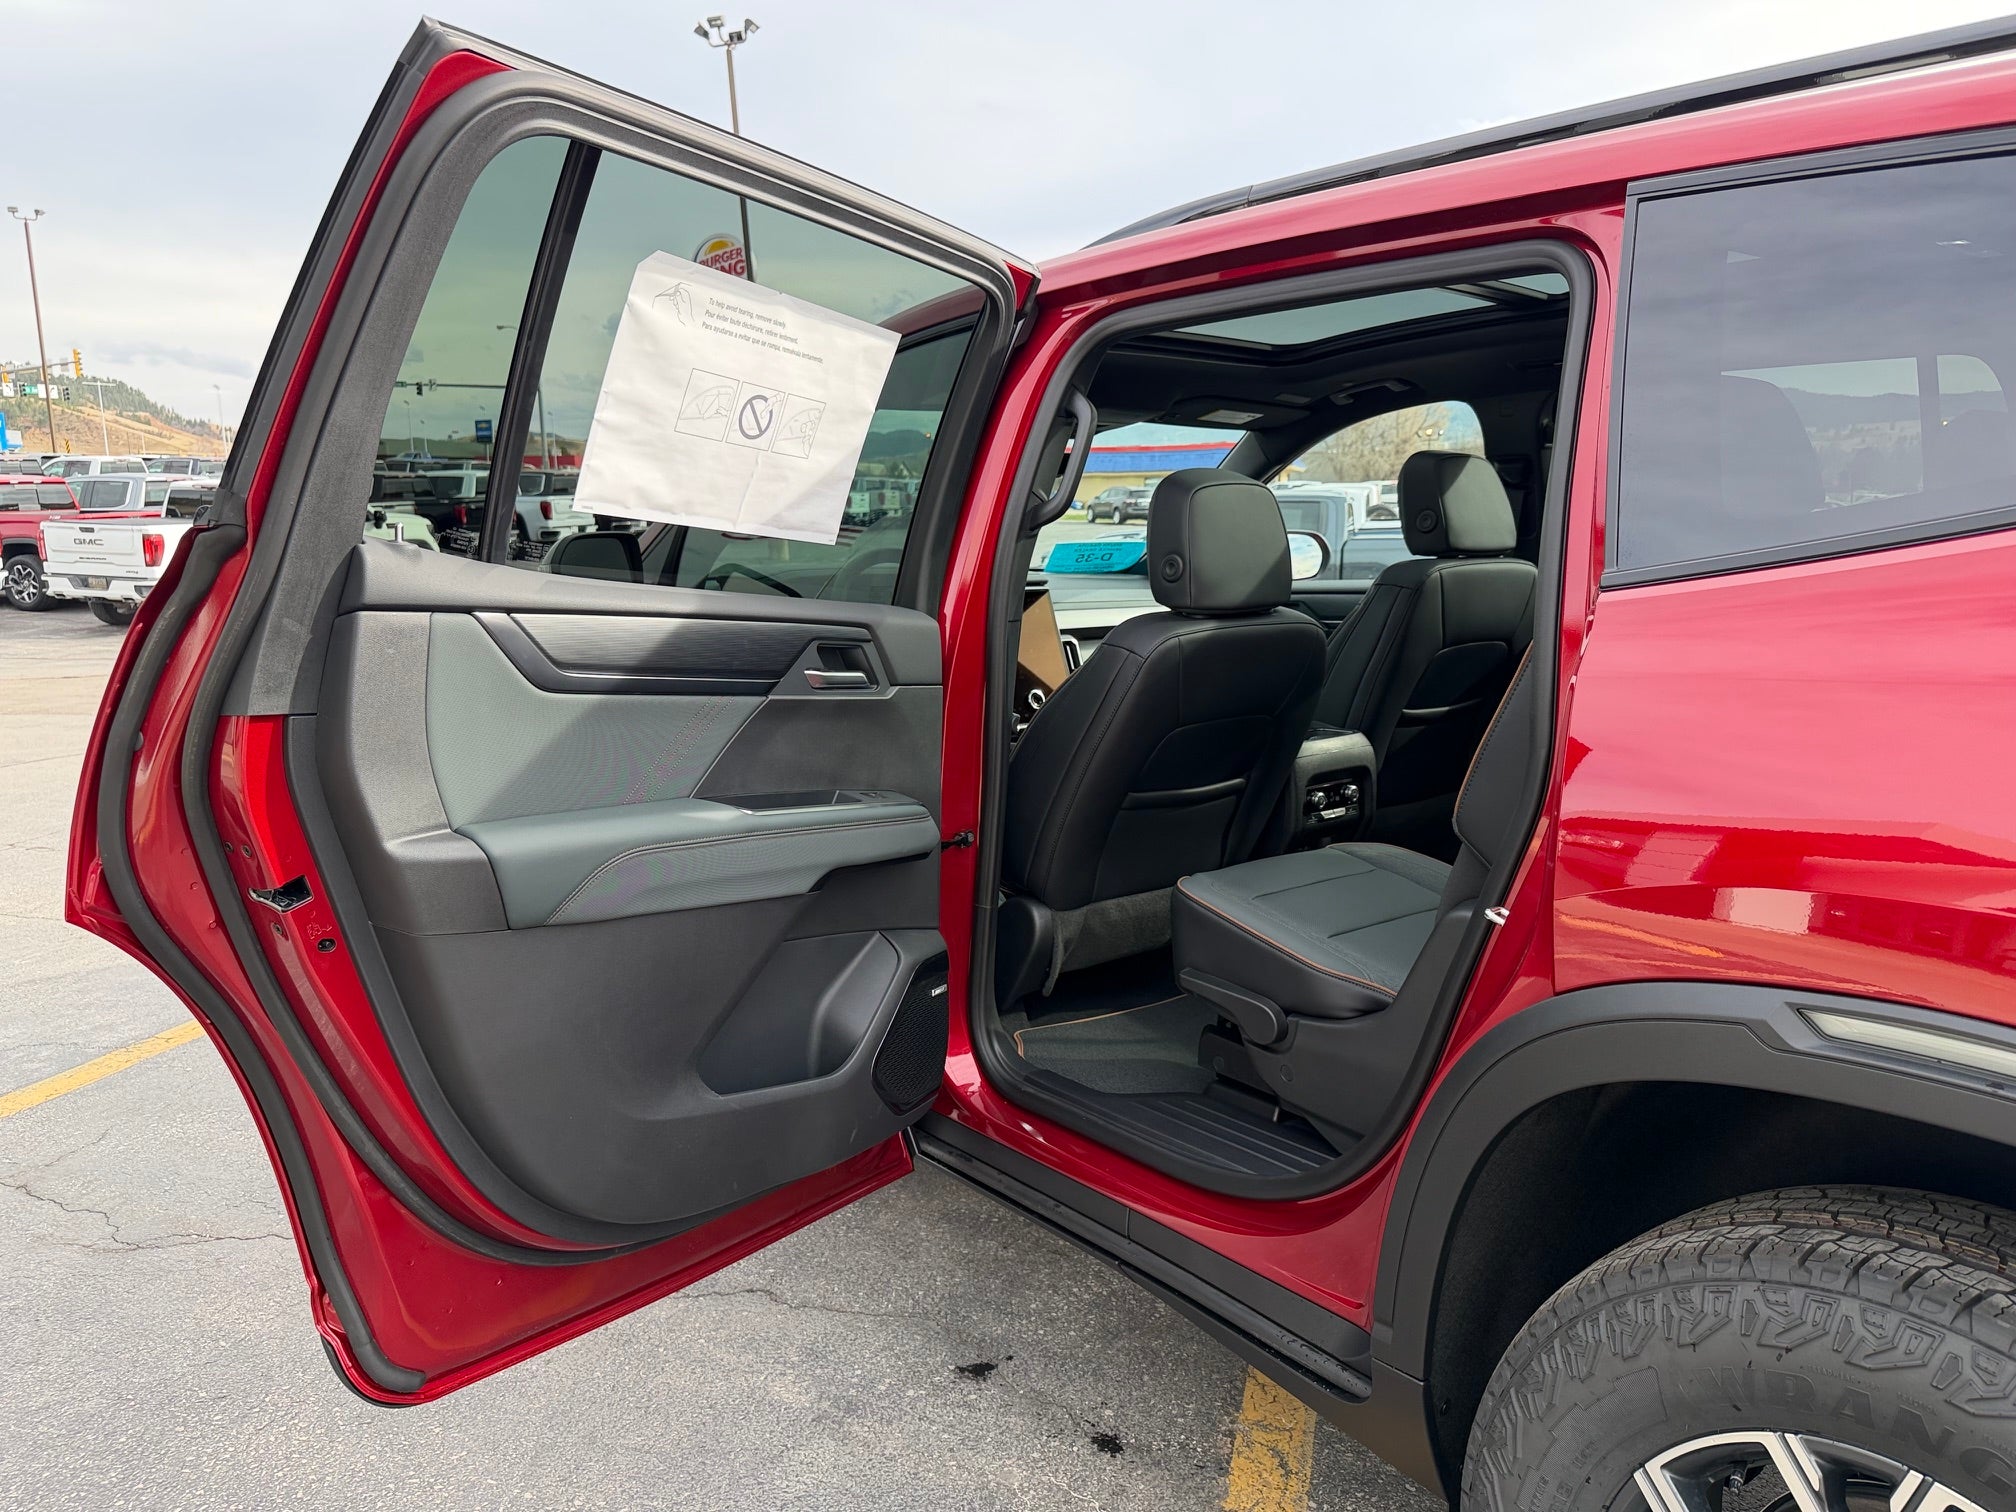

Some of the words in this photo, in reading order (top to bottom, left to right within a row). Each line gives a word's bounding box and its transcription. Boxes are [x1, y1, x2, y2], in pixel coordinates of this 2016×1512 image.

[704, 309, 716, 318] Pour
[730, 317, 742, 326] toute
[764, 328, 778, 338] retirer
[709, 297, 715, 305] To
[715, 299, 725, 310] help
[726, 303, 738, 312] avoid
[738, 307, 754, 319] tearing,
[755, 314, 772, 324] remove
[702, 321, 713, 331] Para
[713, 326, 734, 337] ayudarse
[738, 333, 751, 342] evitar
[751, 338, 760, 347] que
[74, 538, 104, 546] GMC
